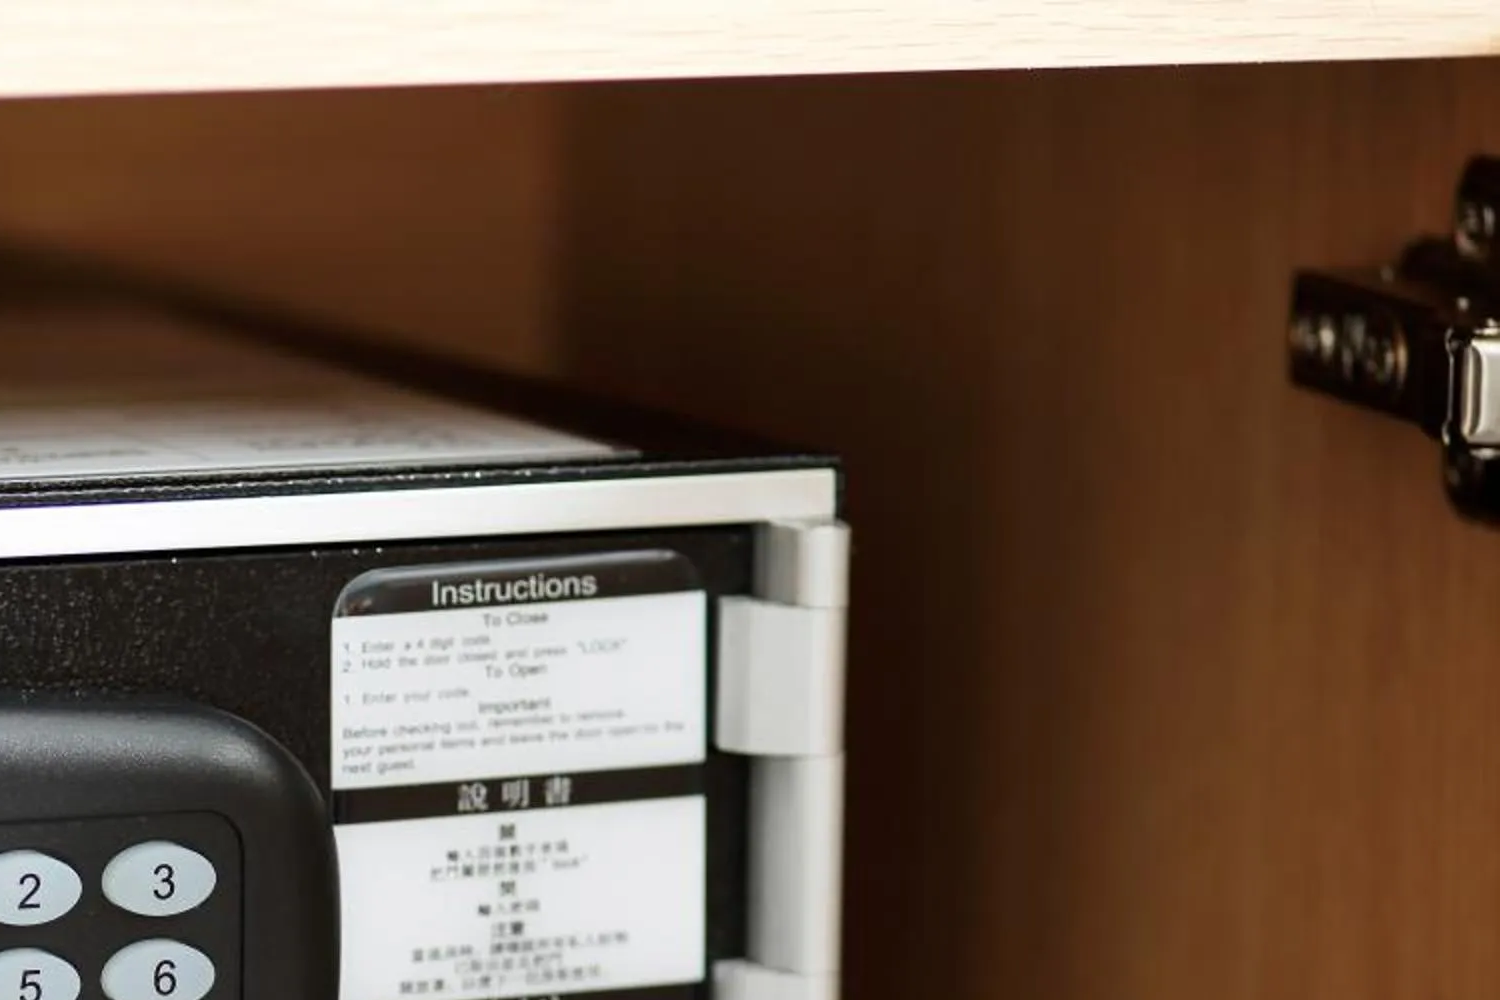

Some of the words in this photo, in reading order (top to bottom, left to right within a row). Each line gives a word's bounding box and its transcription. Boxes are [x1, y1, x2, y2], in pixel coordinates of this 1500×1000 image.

[432, 573, 597, 606] Instructions
[482, 613, 502, 628] To
[506, 611, 548, 626] Close
[485, 664, 504, 678] To
[508, 662, 548, 678] Open
[478, 697, 551, 715] Important
[18, 873, 41, 909] 2
[153, 864, 175, 900] 3
[153, 960, 176, 996] 6
